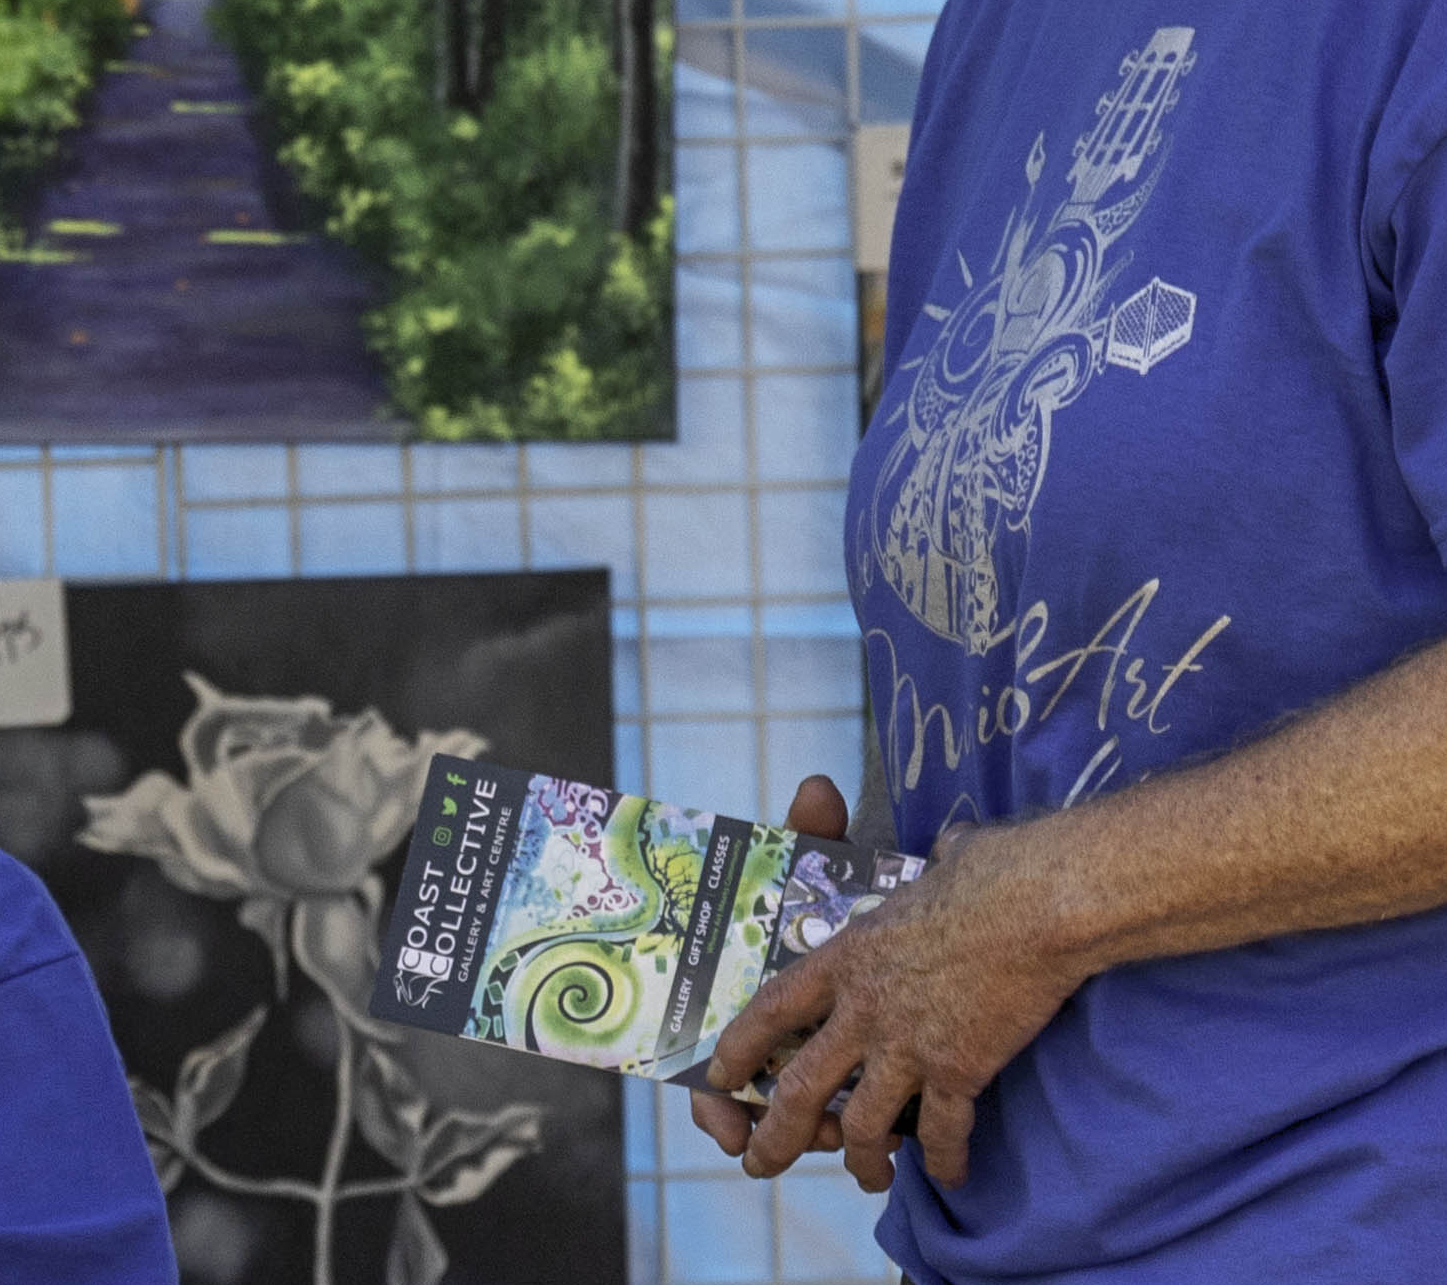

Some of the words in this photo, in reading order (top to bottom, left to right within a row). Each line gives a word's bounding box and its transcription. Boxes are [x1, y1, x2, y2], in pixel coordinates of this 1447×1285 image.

[1026, 577, 1232, 734] Art
[488, 805, 513, 864] CENTRE
[707, 833, 730, 888] CLASSES
[428, 777, 497, 979] COLLECTIVE
[476, 900, 486, 913] &
[480, 868, 496, 898] ART
[399, 860, 446, 972] COAST
[694, 899, 714, 936] SHOP
[458, 916, 483, 982] GALLERY
[687, 936, 705, 966] GIFT
[669, 976, 694, 1033] GALLERY
